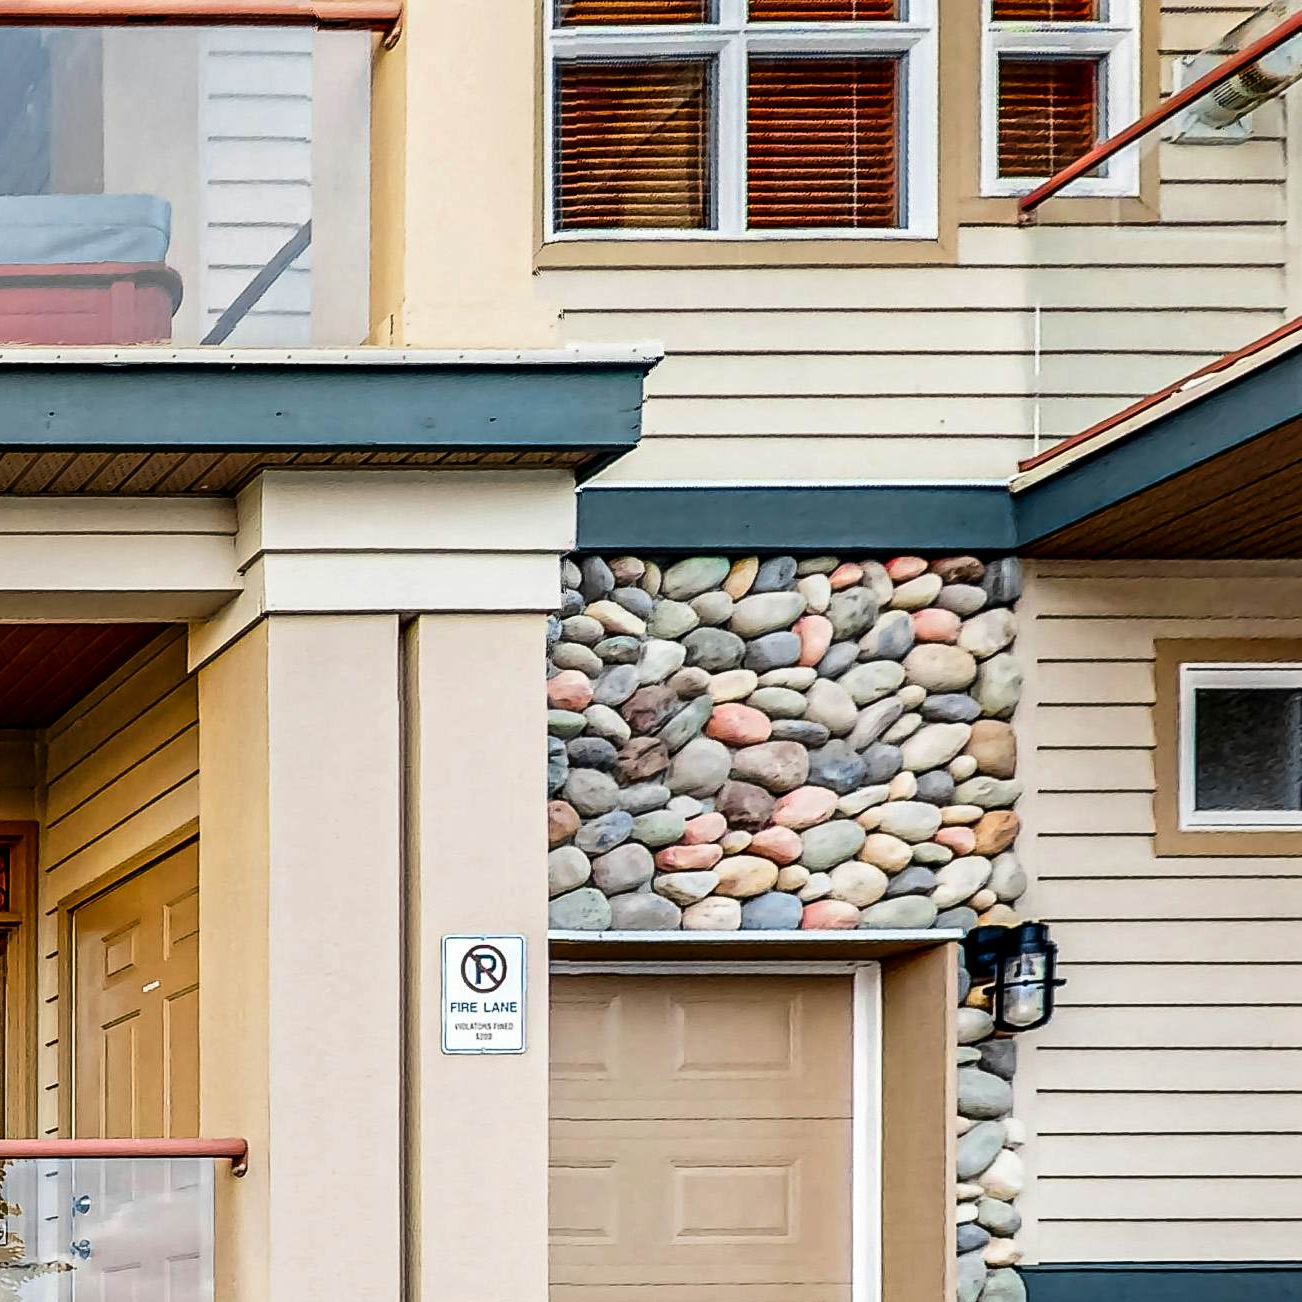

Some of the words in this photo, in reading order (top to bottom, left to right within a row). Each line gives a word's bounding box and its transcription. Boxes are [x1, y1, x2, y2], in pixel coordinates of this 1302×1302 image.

[450, 1002, 478, 1013] FIRE
[484, 1002, 518, 1013] LANE
[454, 1022, 492, 1031] VIOLATORS
